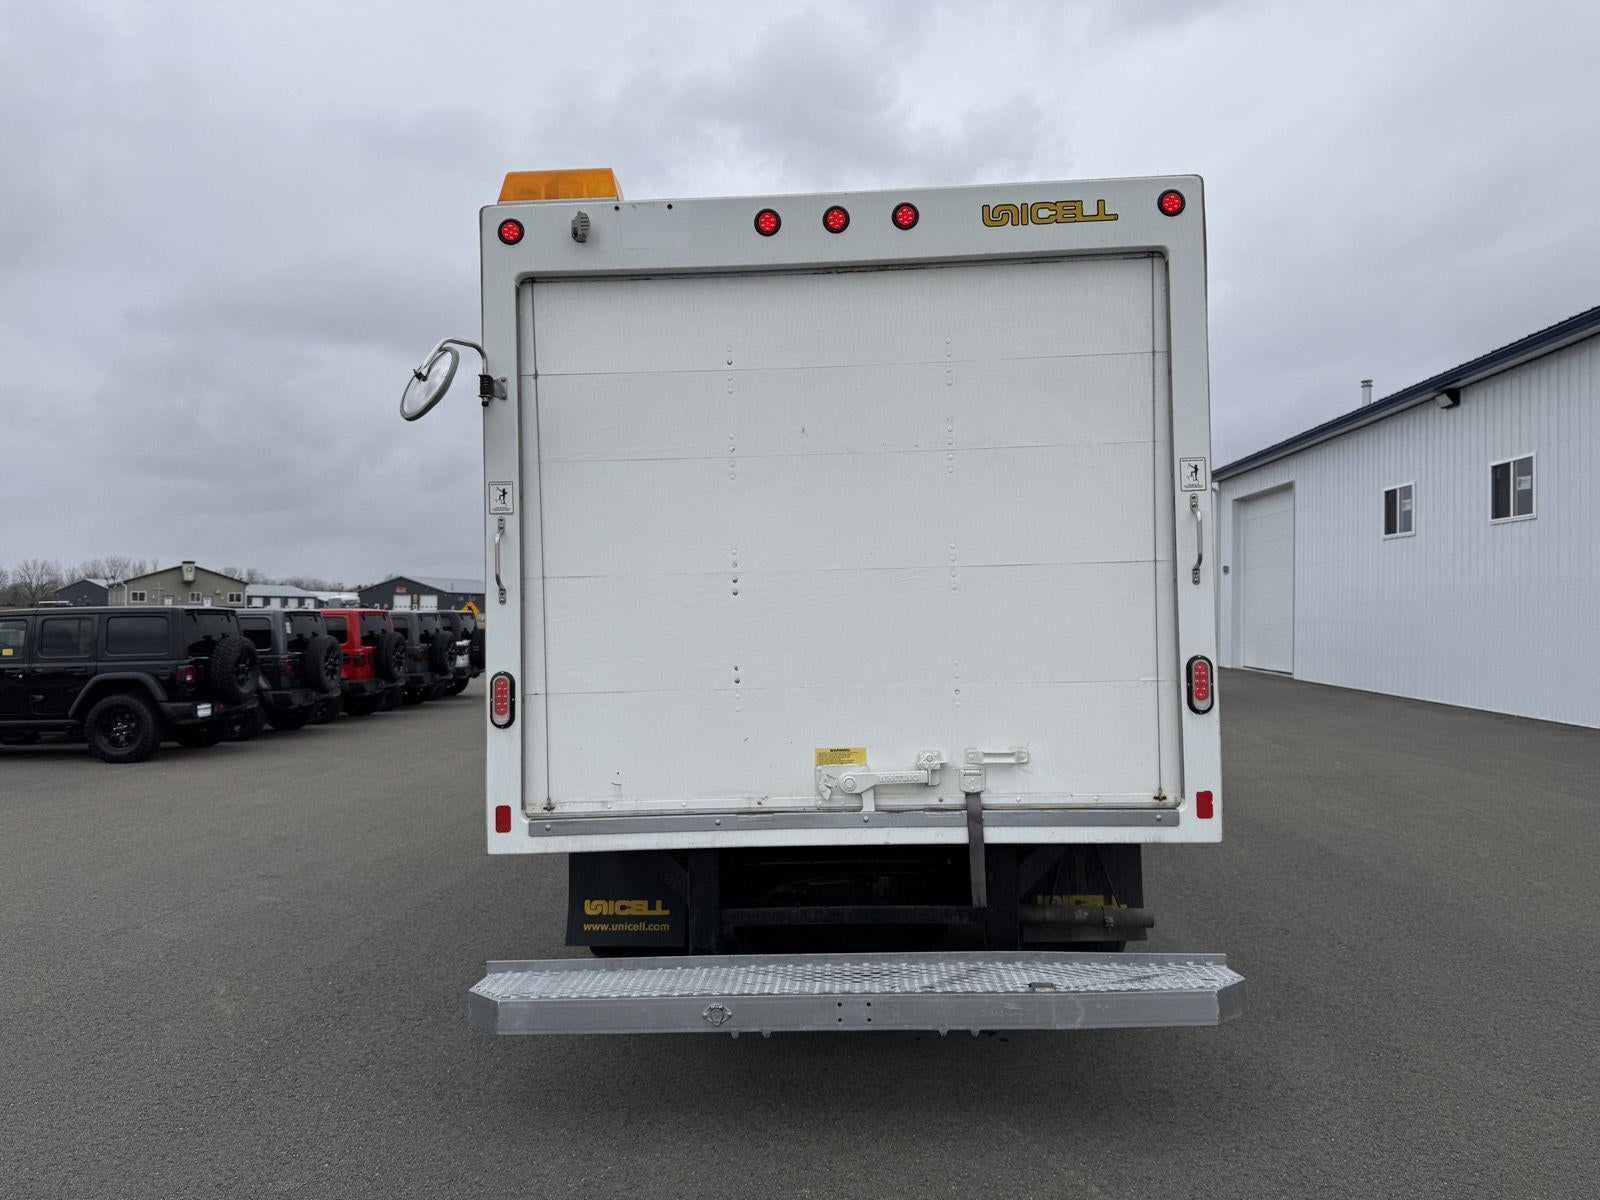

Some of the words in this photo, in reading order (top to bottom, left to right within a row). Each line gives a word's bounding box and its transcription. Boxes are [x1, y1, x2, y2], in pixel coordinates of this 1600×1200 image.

[982, 199, 1119, 227] UNICELL
[584, 899, 671, 916] UNICELL
[583, 922, 670, 932] www.unicell.com
